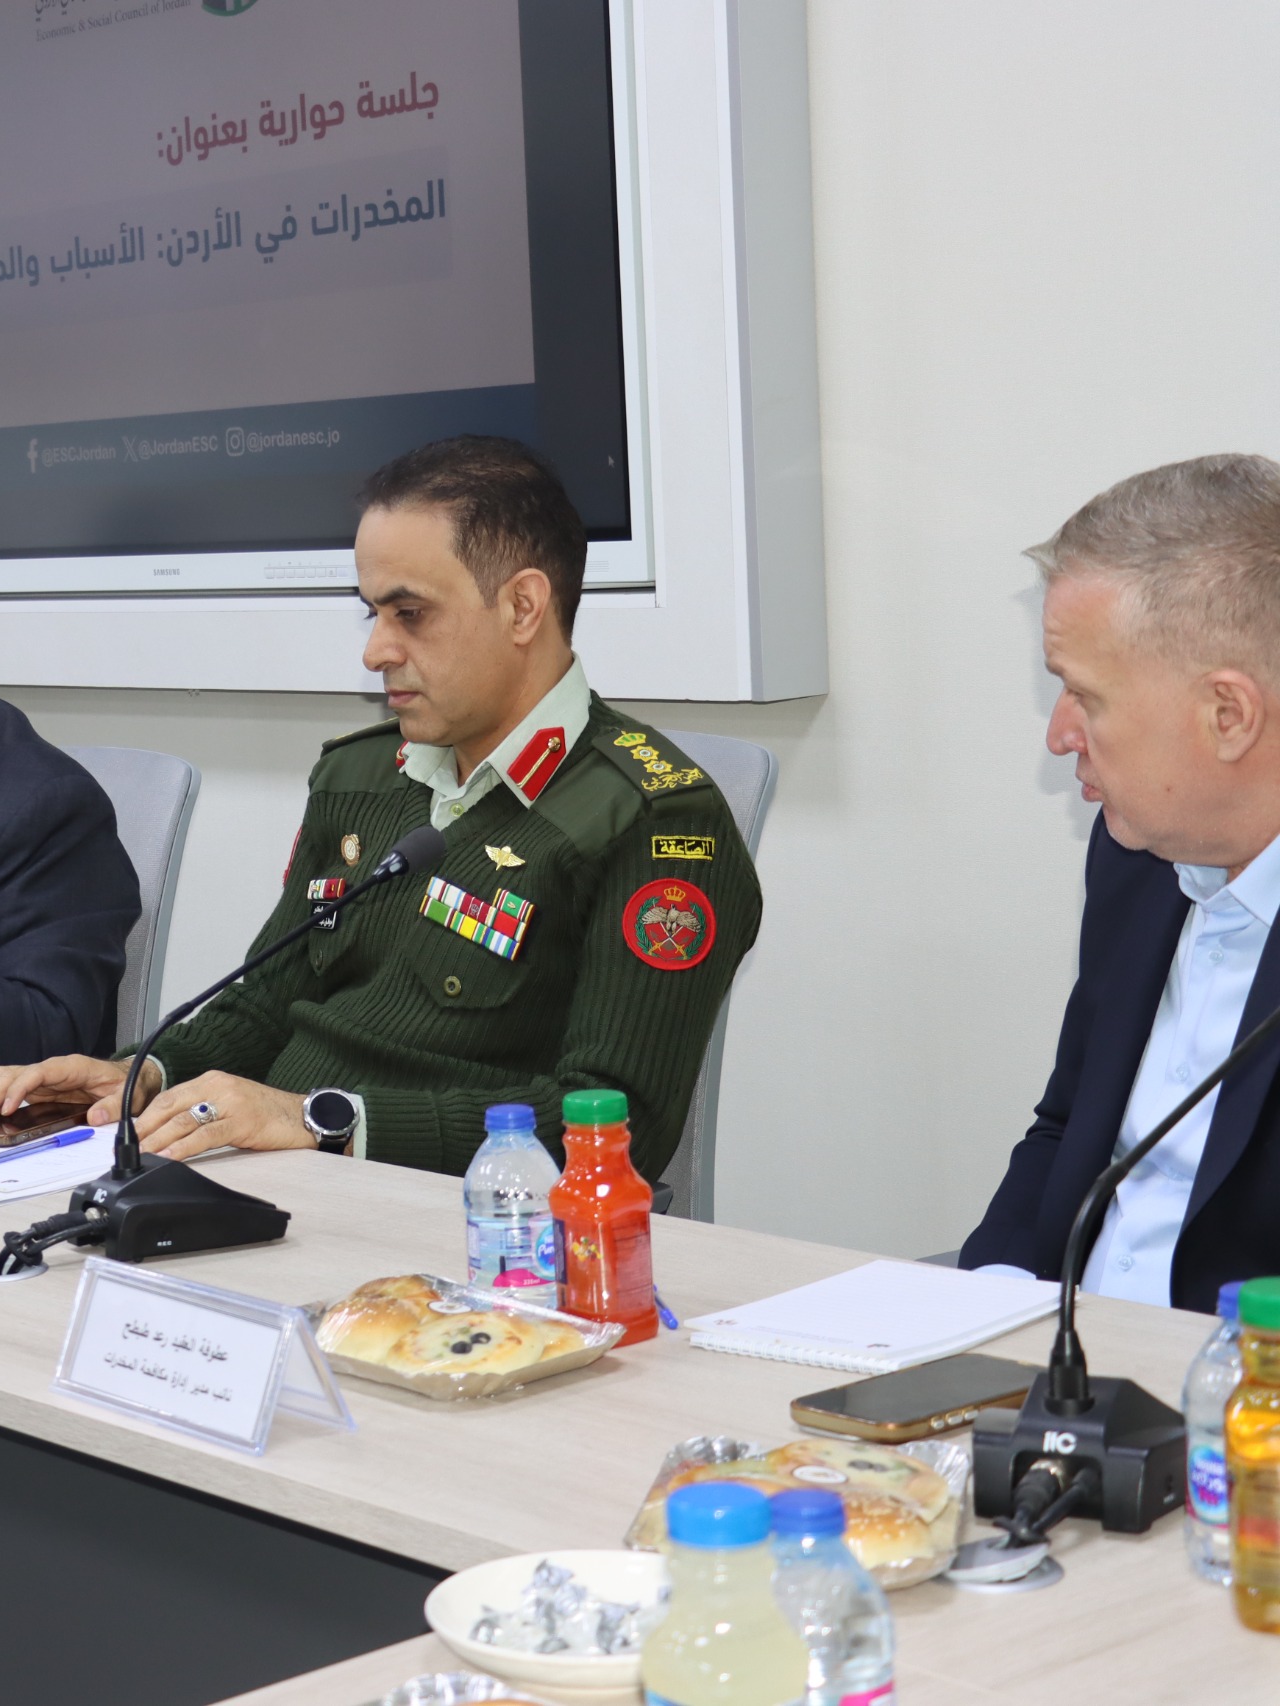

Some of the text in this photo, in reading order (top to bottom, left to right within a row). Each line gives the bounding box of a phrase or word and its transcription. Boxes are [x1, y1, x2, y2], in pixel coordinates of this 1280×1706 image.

[36, 0, 191, 42] Economic & Social Council of Jordan
[157, 71, 439, 167] جلسة حوارية بعنوان:
[311, 178, 446, 242] المخدرات
[157, 207, 242, 267] الأردن:
[254, 204, 298, 265] في
[50, 223, 146, 284] الأسباب
[42, 427, 340, 468] @ESCJordan @JordanESC @jordanesc.jo
[153, 568, 180, 576] SAMSUNG
[538, 1243, 555, 1258] Pur
[153, 1330, 169, 1348] رعد
[172, 1334, 196, 1352] العقيد
[199, 1338, 228, 1362] عطوفة
[104, 1352, 138, 1371] المخدرات
[140, 1359, 168, 1381] مكافحة
[190, 1384, 209, 1395] مدير
[212, 1388, 232, 1402] نائب
